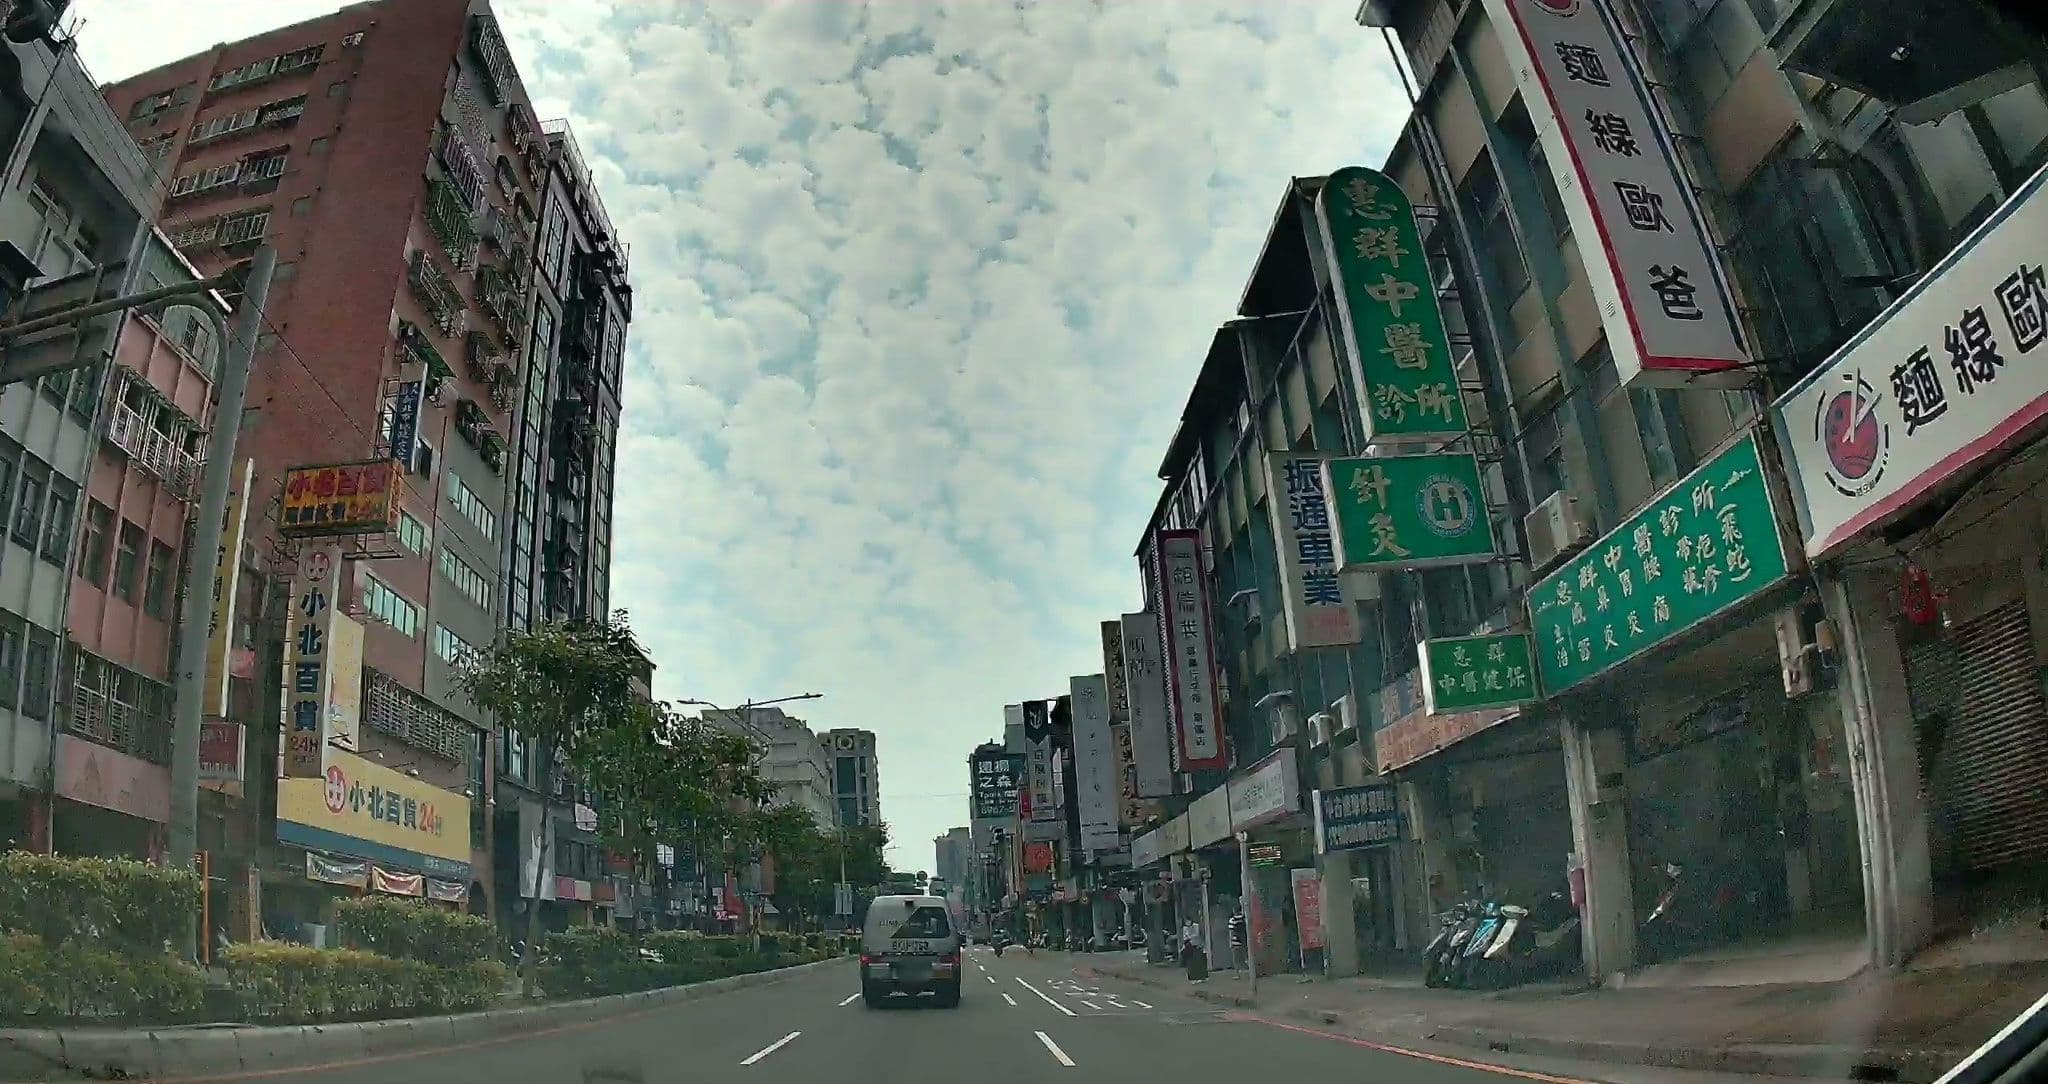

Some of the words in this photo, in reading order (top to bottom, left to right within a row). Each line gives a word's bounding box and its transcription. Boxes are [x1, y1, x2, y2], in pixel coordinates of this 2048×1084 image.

[1554, 40, 1703, 321] 麵線歐爸
[1340, 177, 1456, 424] 惠群中醫診所
[1284, 458, 1342, 606] 振通車業
[1348, 465, 1411, 556] 針灸
[292, 586, 326, 731] 小北百貨
